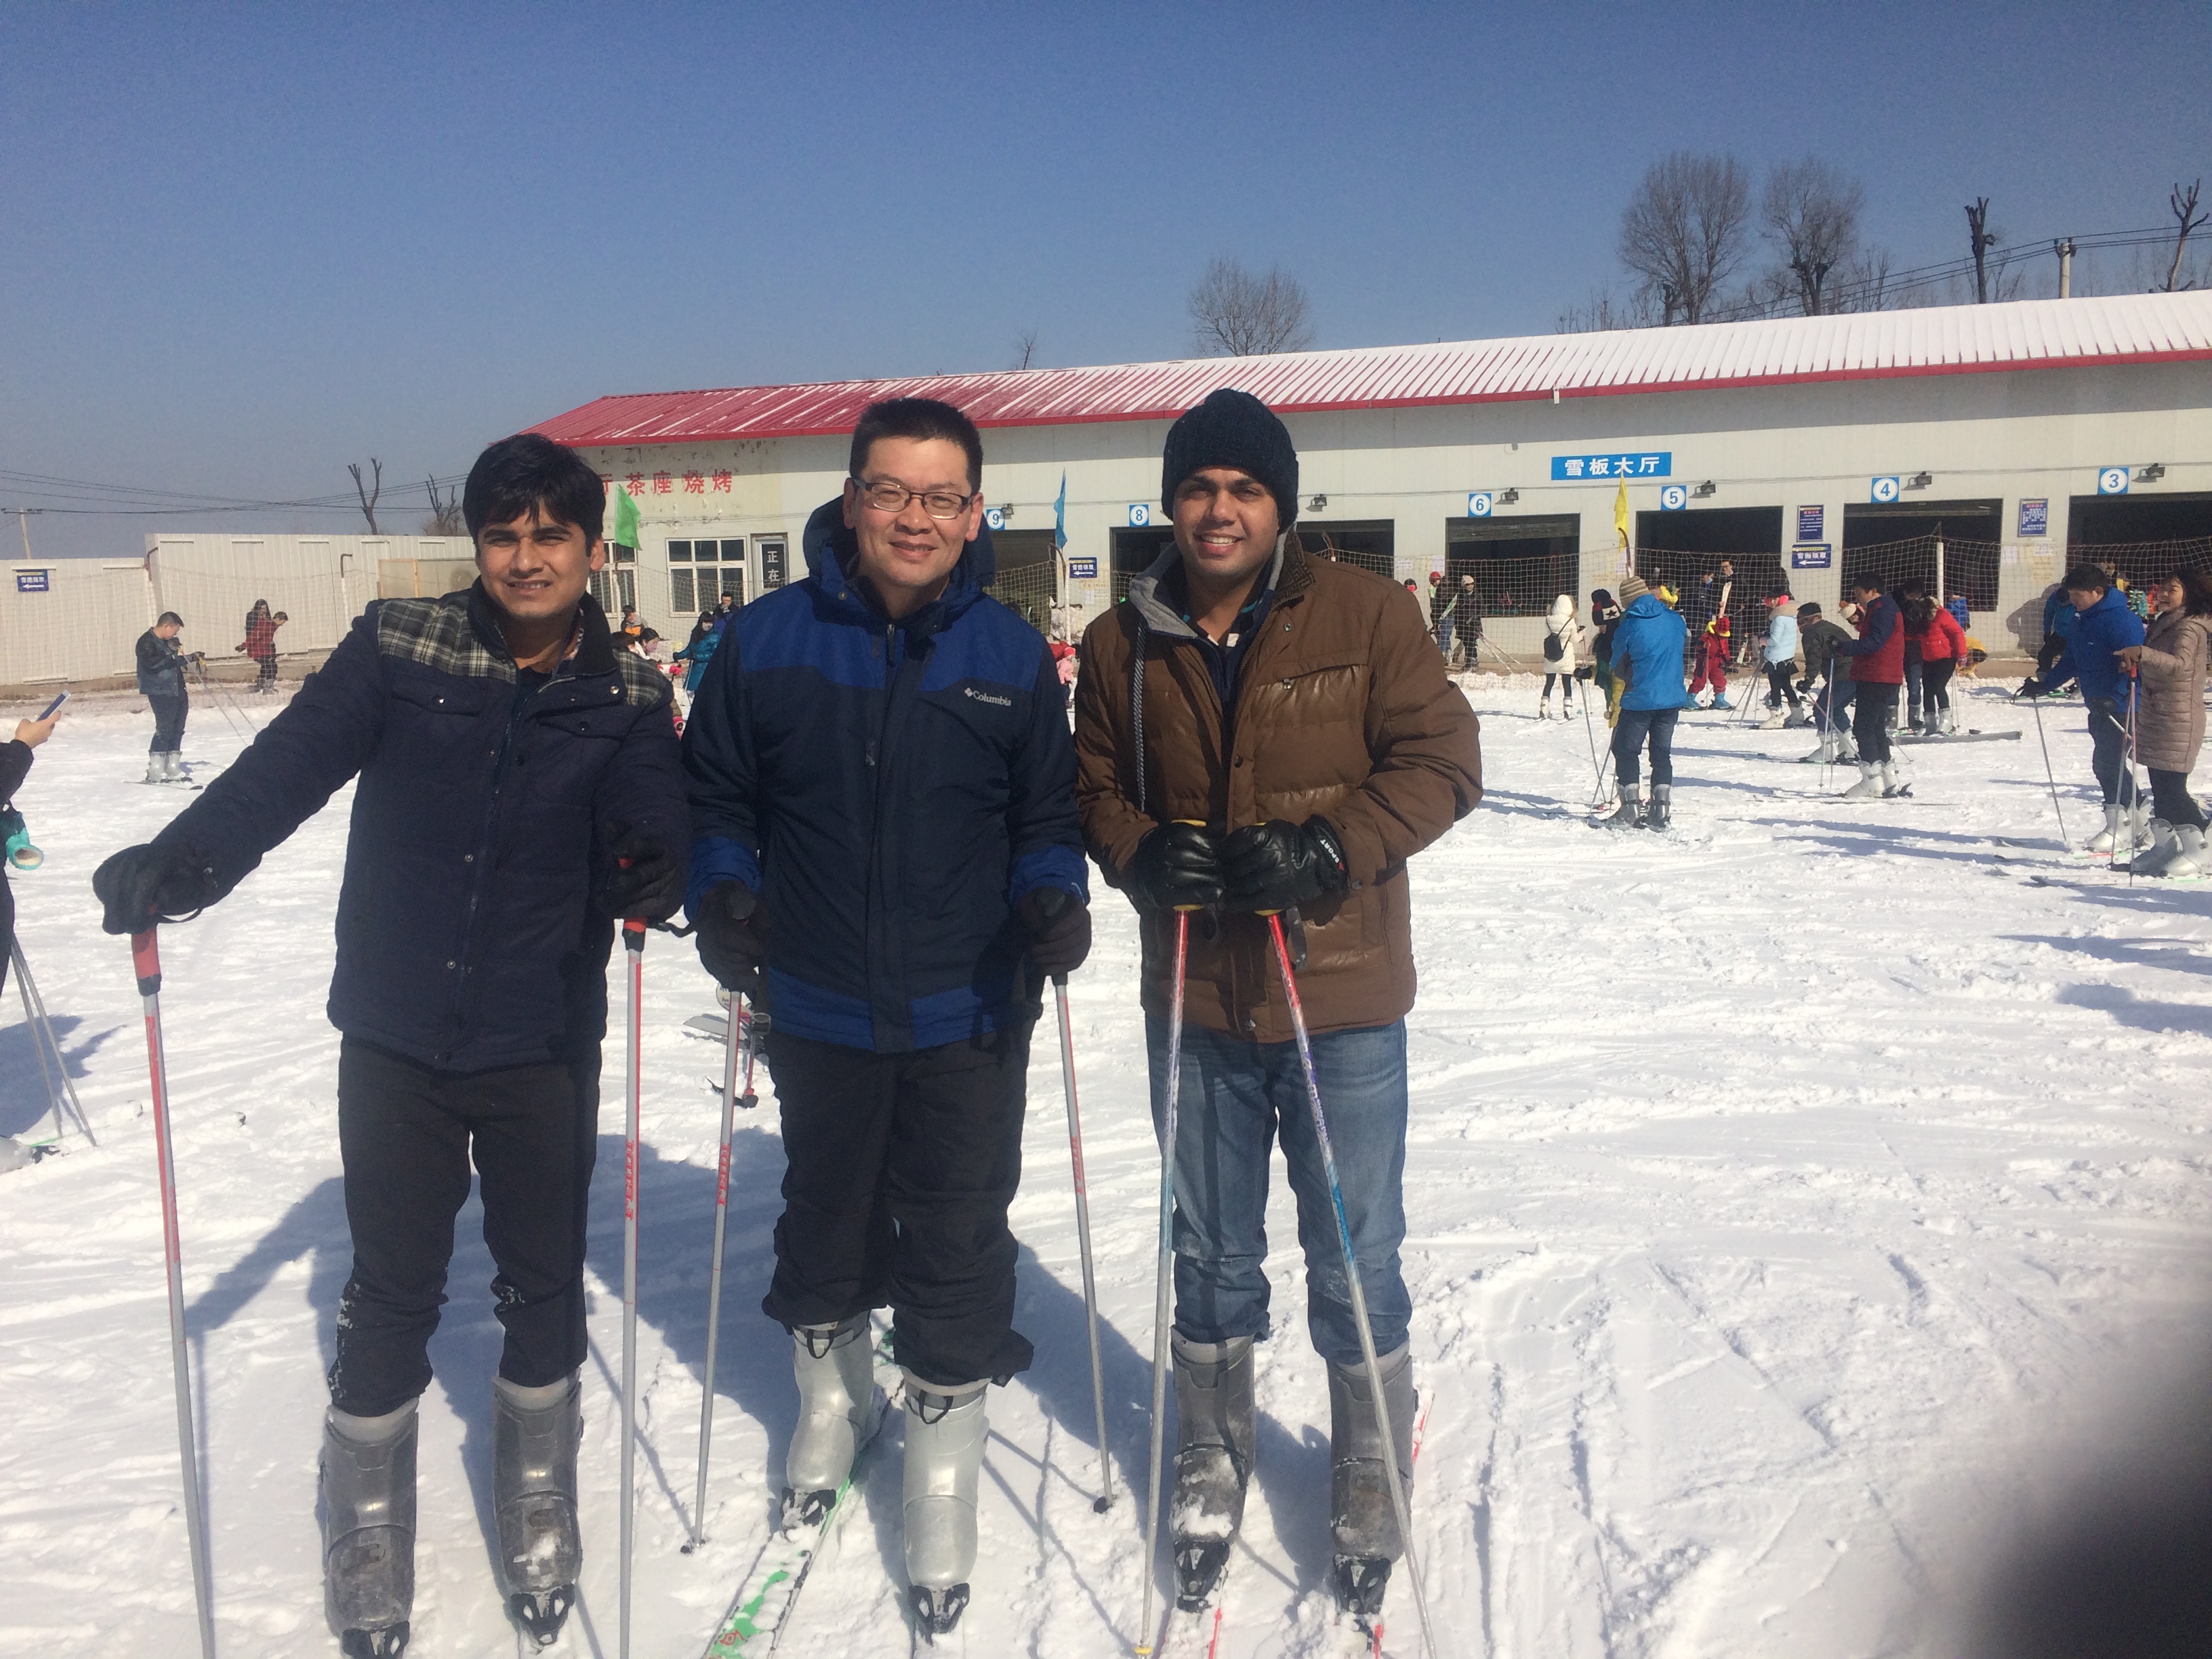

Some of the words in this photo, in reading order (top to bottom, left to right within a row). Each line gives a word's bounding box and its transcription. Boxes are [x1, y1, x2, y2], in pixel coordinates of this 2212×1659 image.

[1564, 457, 1660, 476] 雪板大厅
[2108, 473, 2119, 489] 3
[1880, 483, 1891, 497] 4
[1475, 498, 1484, 512] 6
[1669, 491, 1679, 505] 5
[992, 513, 1000, 525] 9
[1135, 509, 1143, 522] 8
[766, 550, 780, 583] 正在
[972, 690, 1012, 706] Columbia
[1319, 839, 1340, 863] SPORT
